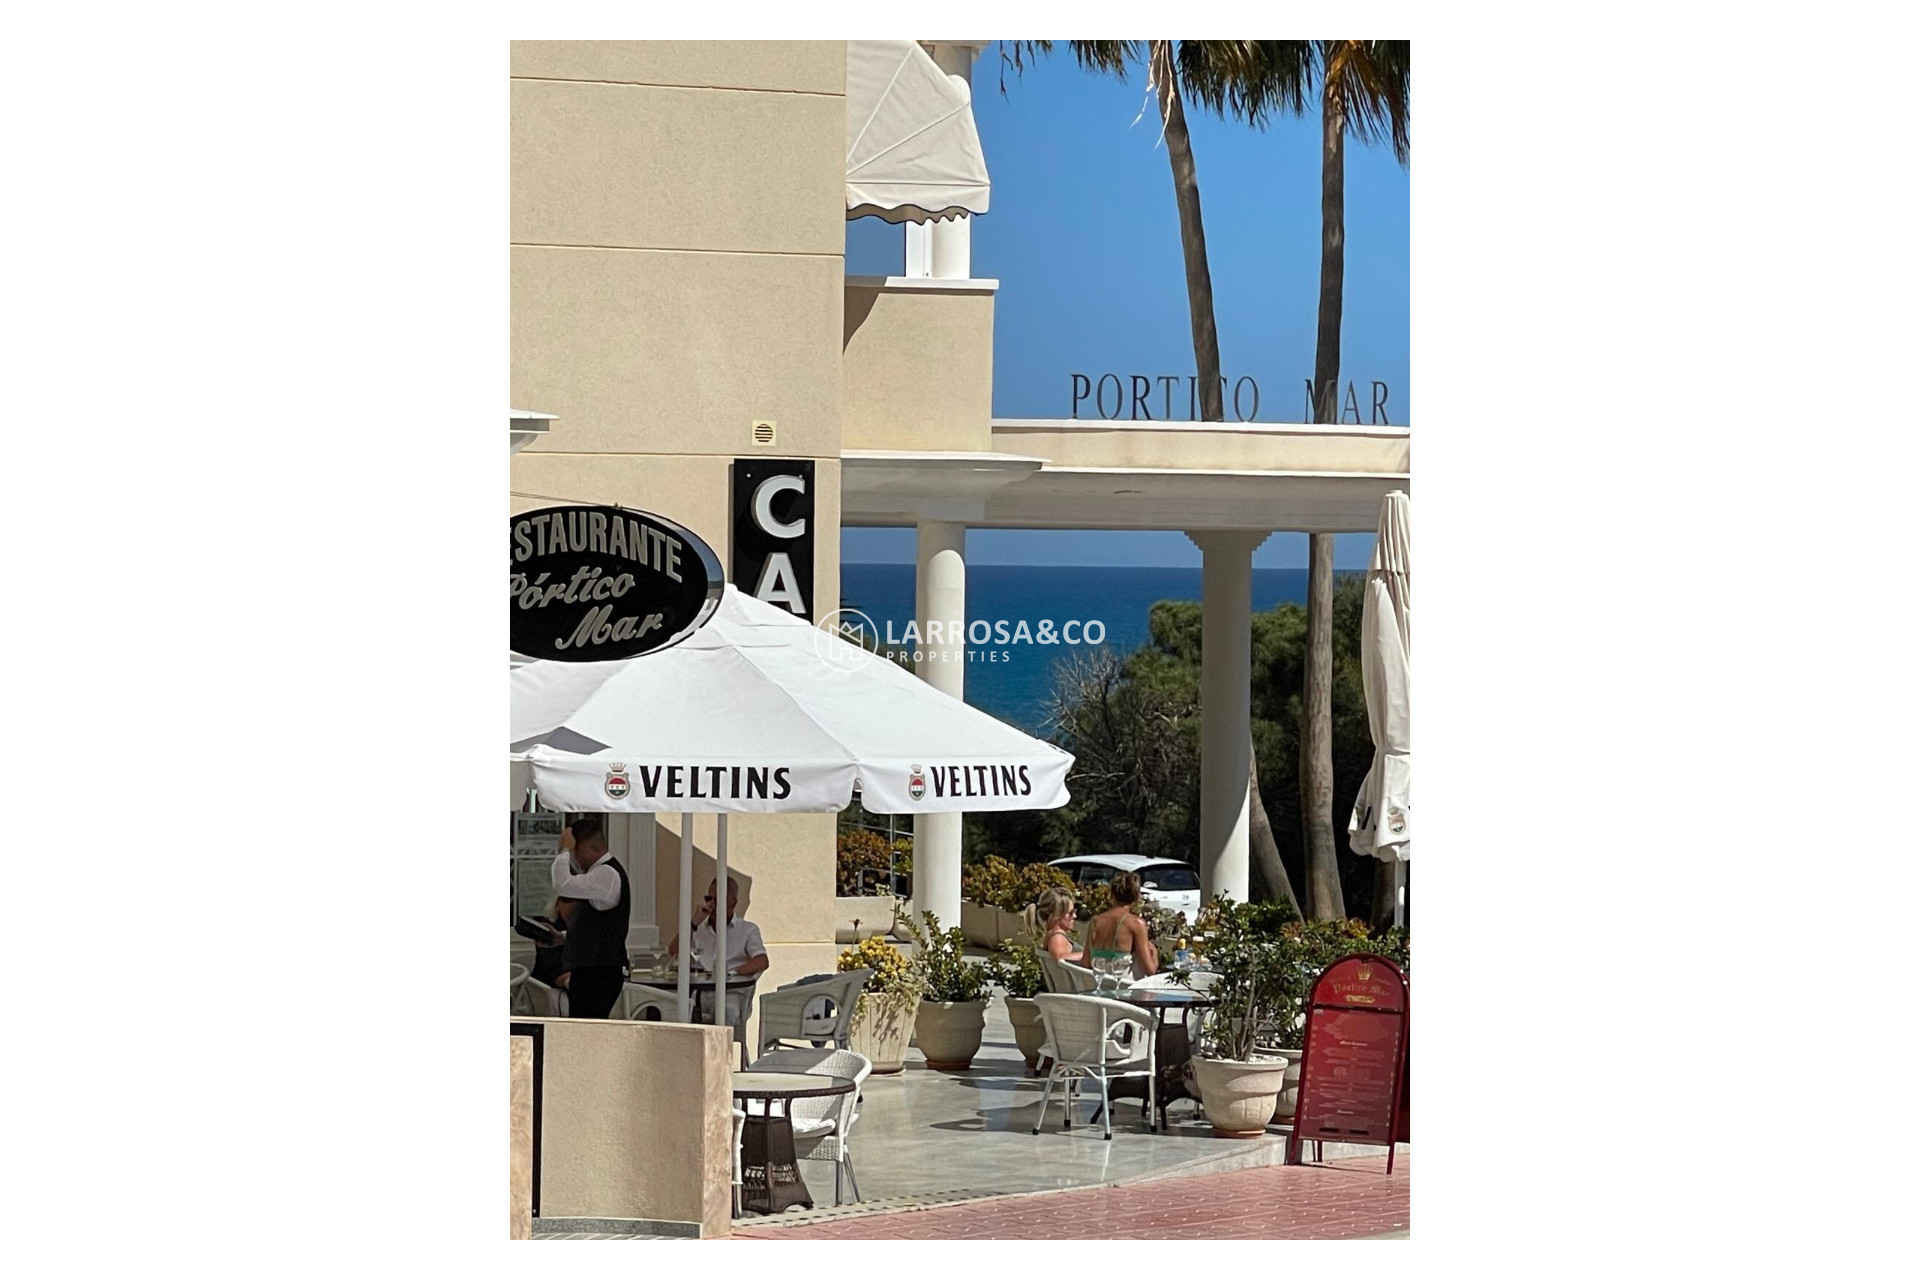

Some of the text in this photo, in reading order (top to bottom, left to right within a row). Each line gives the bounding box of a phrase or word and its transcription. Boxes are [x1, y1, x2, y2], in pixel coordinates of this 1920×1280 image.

[1304, 378, 1390, 425] MAR
[510, 511, 683, 583] STAURANTE
[555, 604, 663, 650] Mar
[639, 765, 791, 800] VELTINS
[930, 764, 1032, 797] VELTINS
